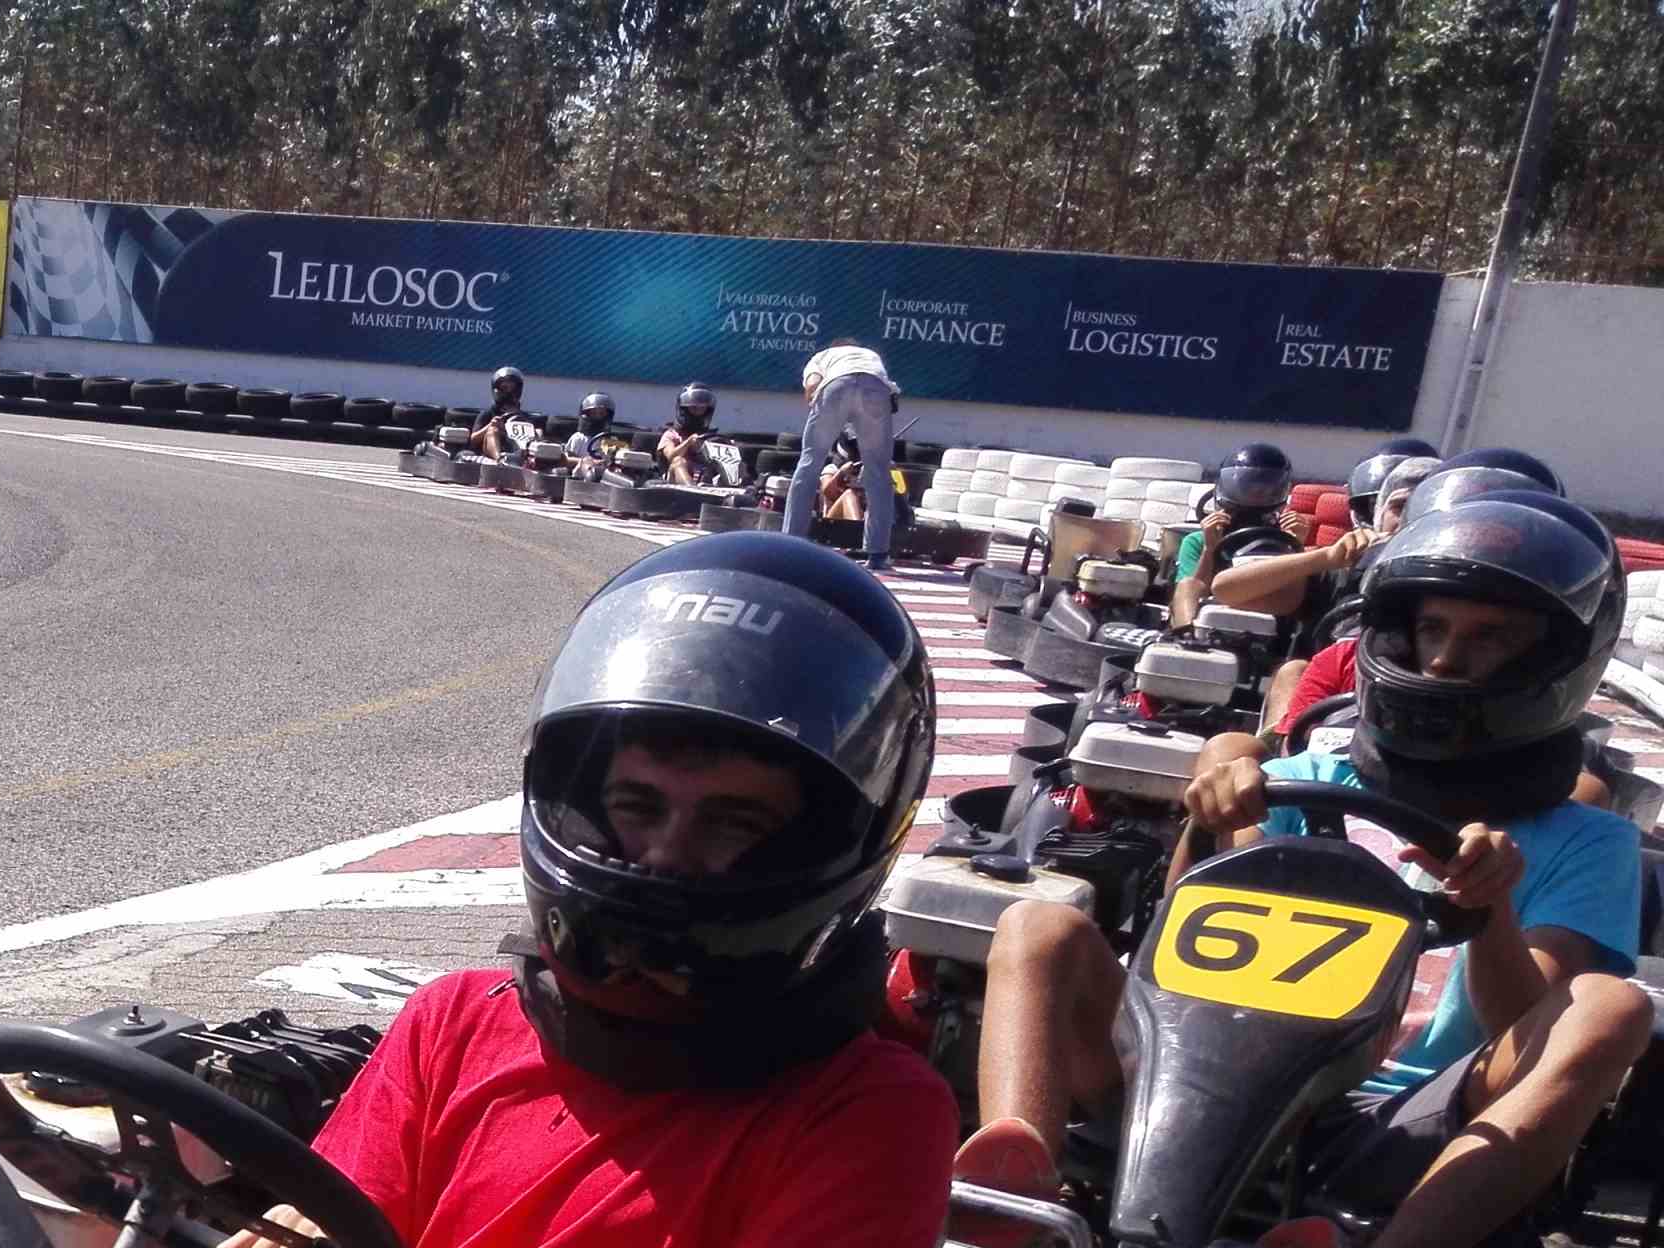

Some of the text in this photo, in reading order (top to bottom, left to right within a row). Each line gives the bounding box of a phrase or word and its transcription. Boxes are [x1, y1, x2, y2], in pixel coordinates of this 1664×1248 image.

[885, 298, 970, 317] CORPORATE
[1072, 309, 1138, 328] BUSINESS
[350, 311, 495, 335] MARKET PARTNERS
[719, 309, 821, 336] ATIVOS
[882, 315, 1007, 348] FINANCE
[1285, 322, 1323, 338] REAL
[1068, 328, 1219, 361] LOGISTICS
[1279, 341, 1394, 373] ESTATE
[661, 591, 784, 636] nau
[1173, 900, 1374, 985] 67
